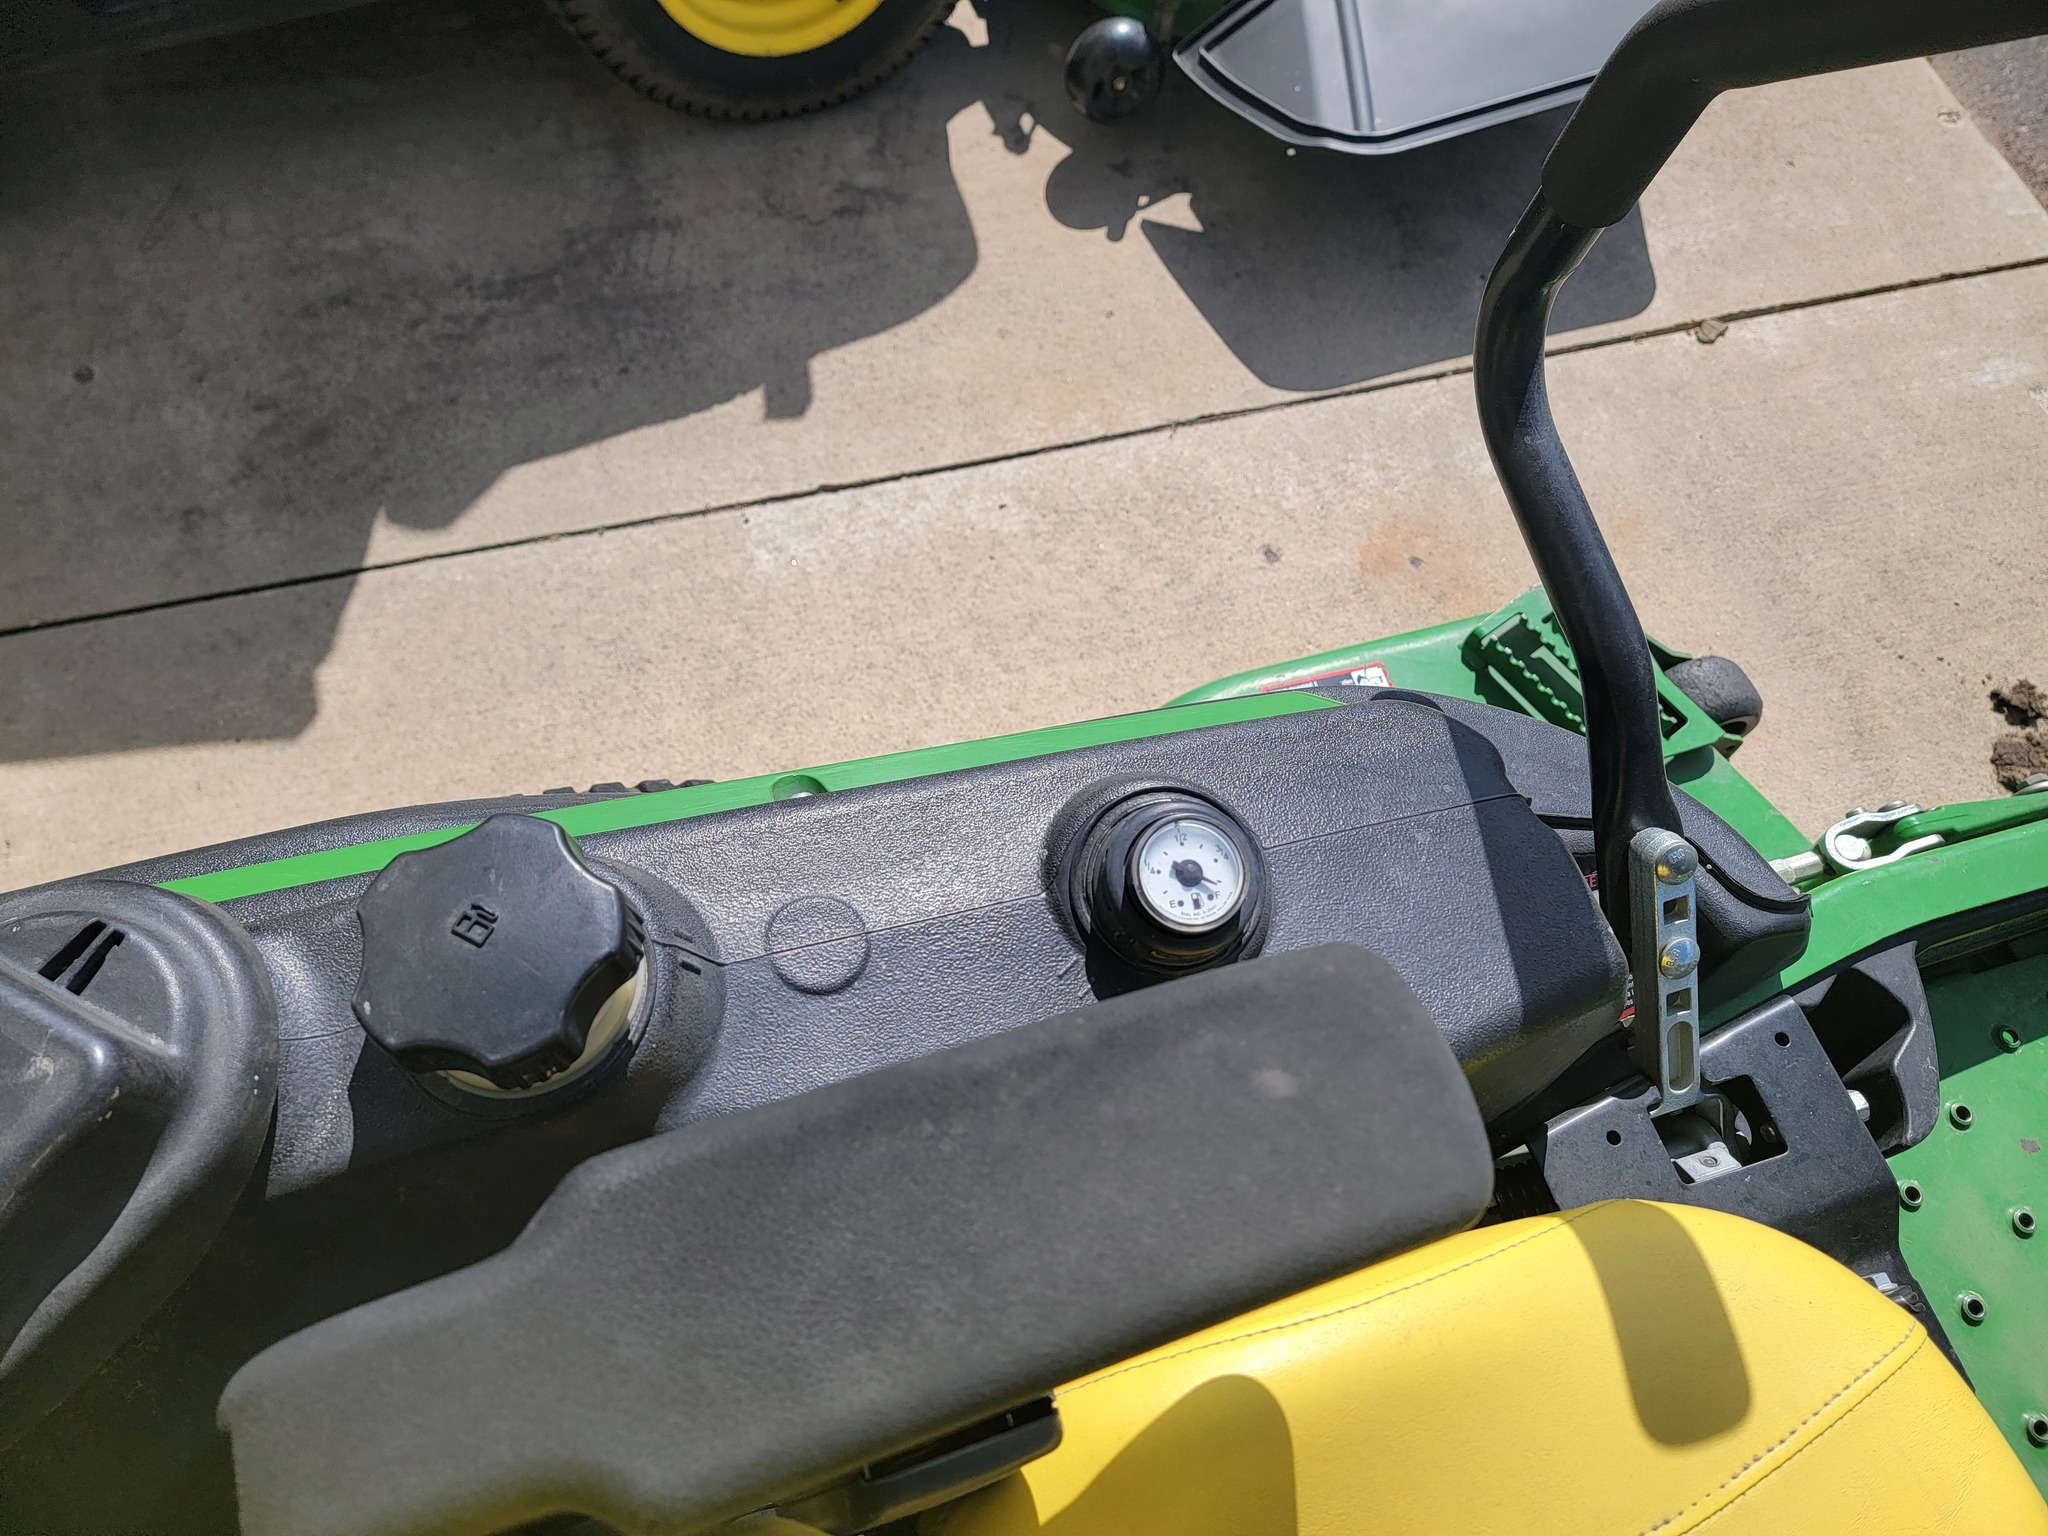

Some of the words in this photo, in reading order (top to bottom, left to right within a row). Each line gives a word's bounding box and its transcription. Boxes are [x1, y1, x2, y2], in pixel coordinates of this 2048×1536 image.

[1174, 833, 1187, 842] 1/2
[1215, 845, 1229, 860] 3/4
[1215, 891, 1220, 899] F
[1169, 900, 1176, 908] E
